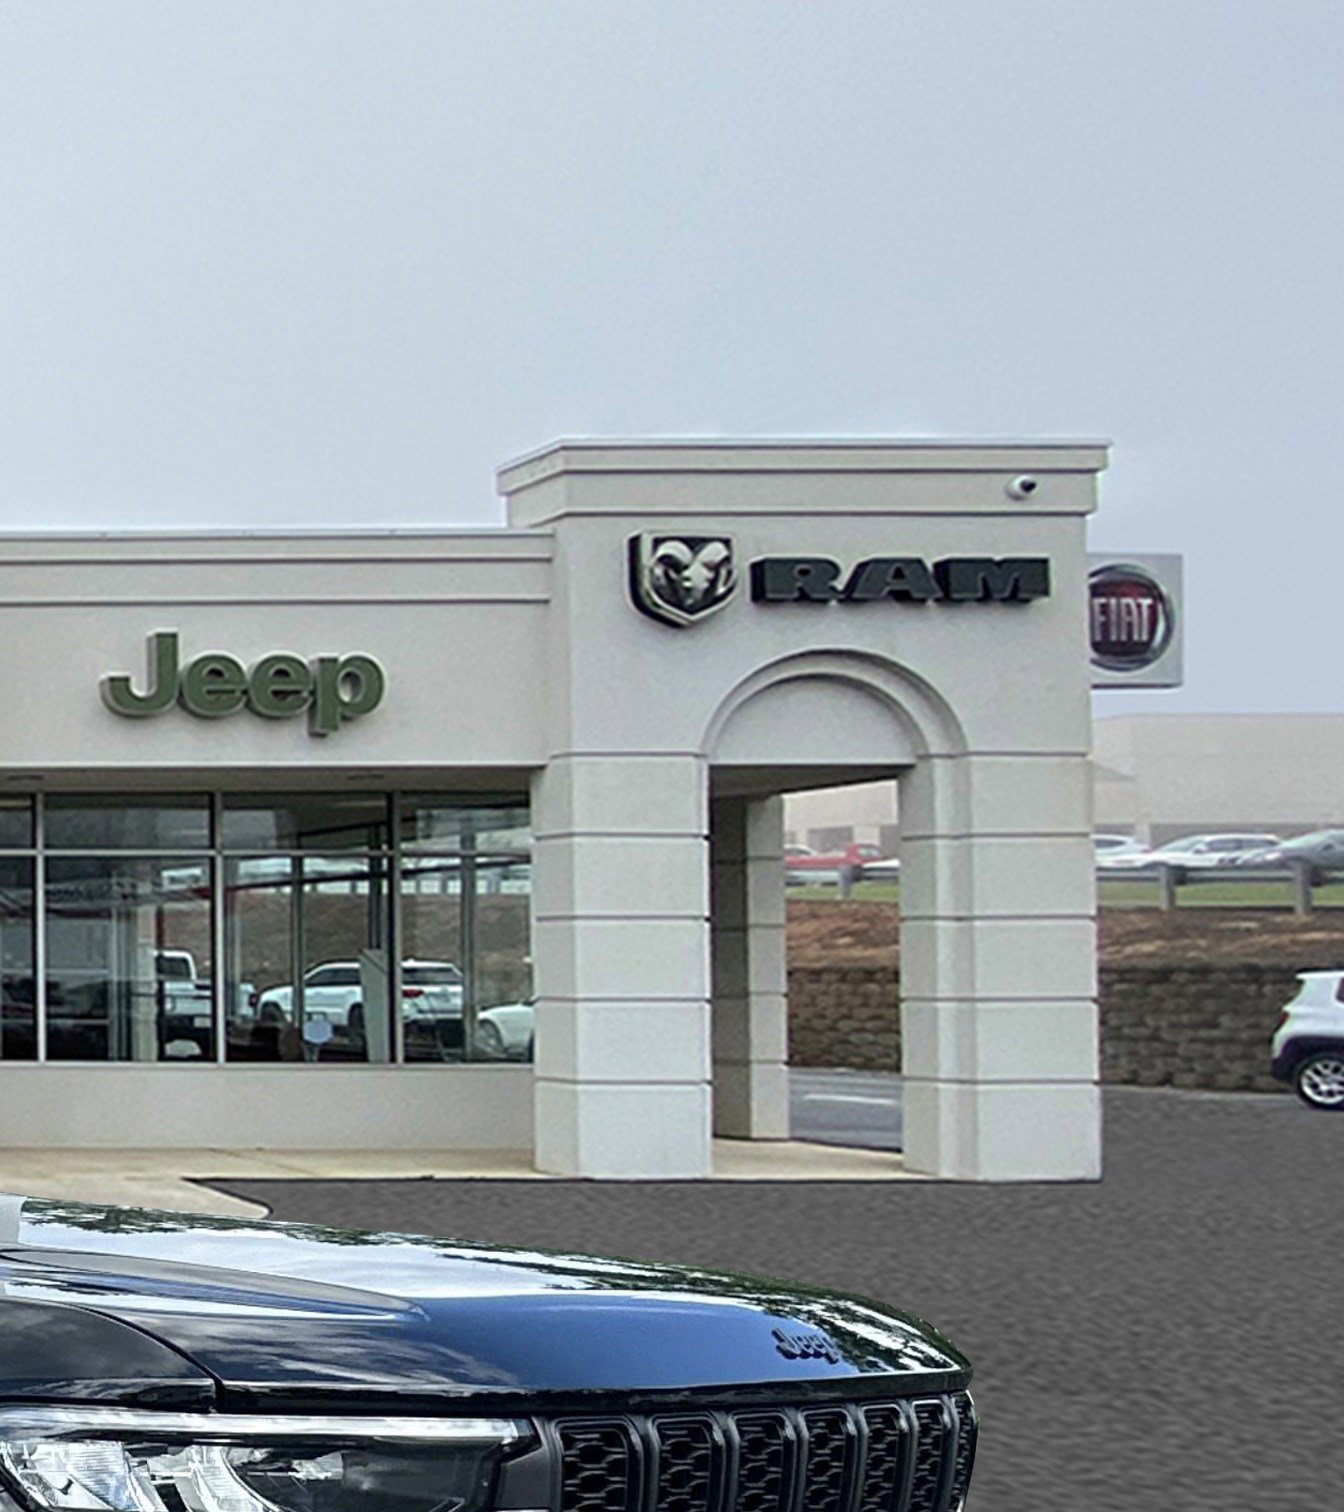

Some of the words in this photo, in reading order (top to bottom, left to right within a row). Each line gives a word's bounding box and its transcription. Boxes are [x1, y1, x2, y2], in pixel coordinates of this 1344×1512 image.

[749, 557, 1051, 604] RAM
[1092, 597, 1153, 642] FIAT
[100, 630, 386, 738] Jeep
